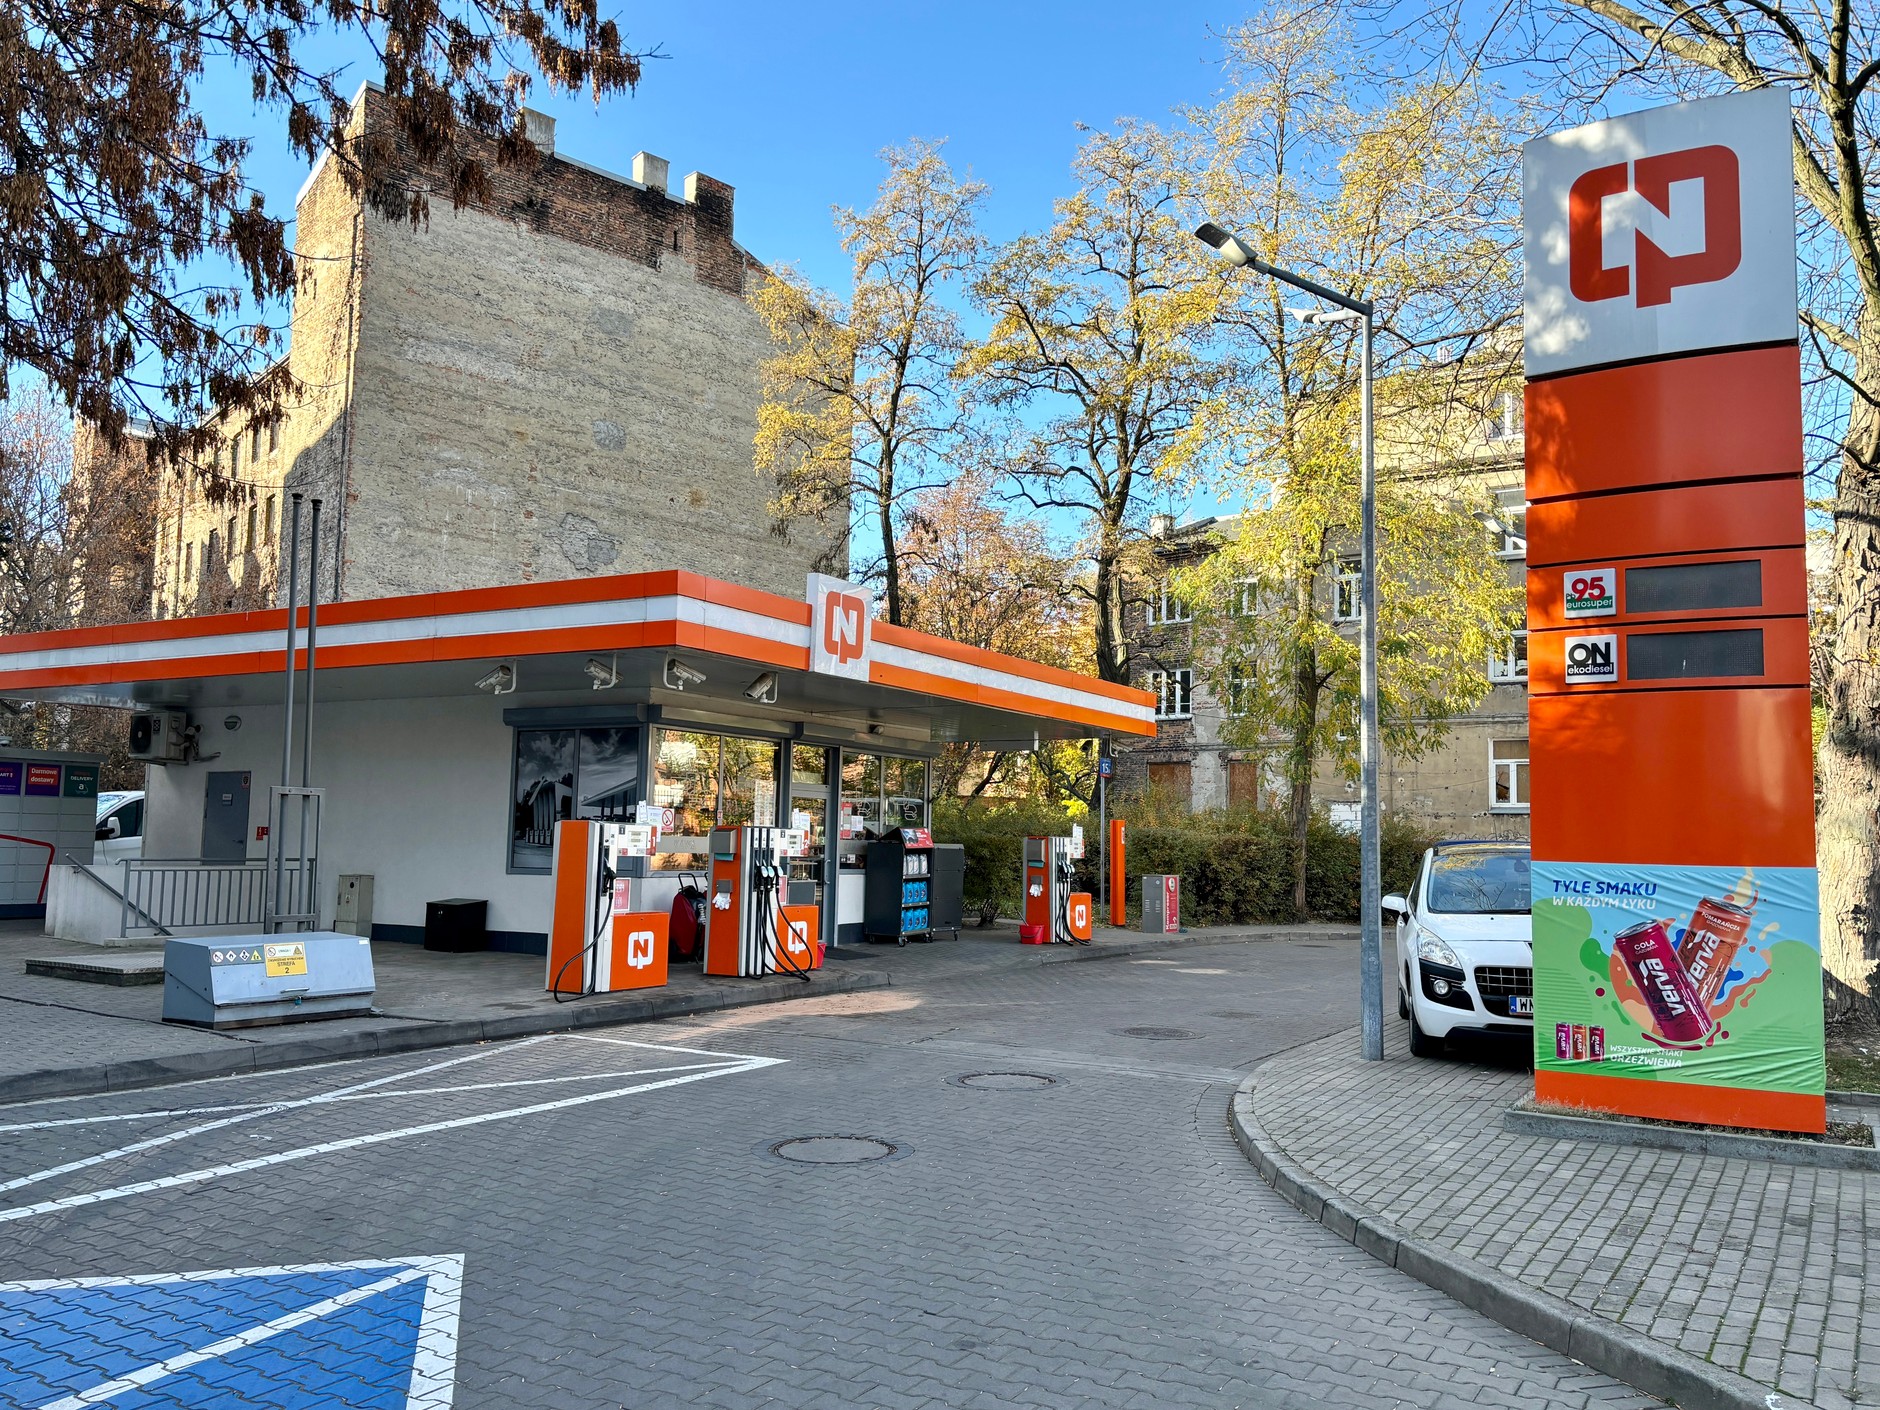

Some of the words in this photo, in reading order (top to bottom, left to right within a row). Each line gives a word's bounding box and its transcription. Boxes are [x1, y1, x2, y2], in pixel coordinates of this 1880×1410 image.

[1571, 576, 1606, 601] 95
[1566, 599, 1612, 609] eurosuper
[1568, 642, 1611, 665] ON
[1568, 662, 1613, 675] ekodiesel
[31, 767, 58, 775] Darmowe
[30, 776, 54, 784] dostawy
[1552, 880, 1591, 893] TYLE
[1595, 881, 1657, 896] SMAKU
[1552, 896, 1564, 906] W
[1566, 895, 1619, 908] KAŻDYM
[1622, 898, 1657, 910] ŁYKU
[1633, 939, 1656, 950] COLA
[1645, 957, 1687, 1017] verva
[1610, 1045, 1654, 1055] WSZYSTKIE
[1610, 1054, 1682, 1068] ORZEŹWIENIA
